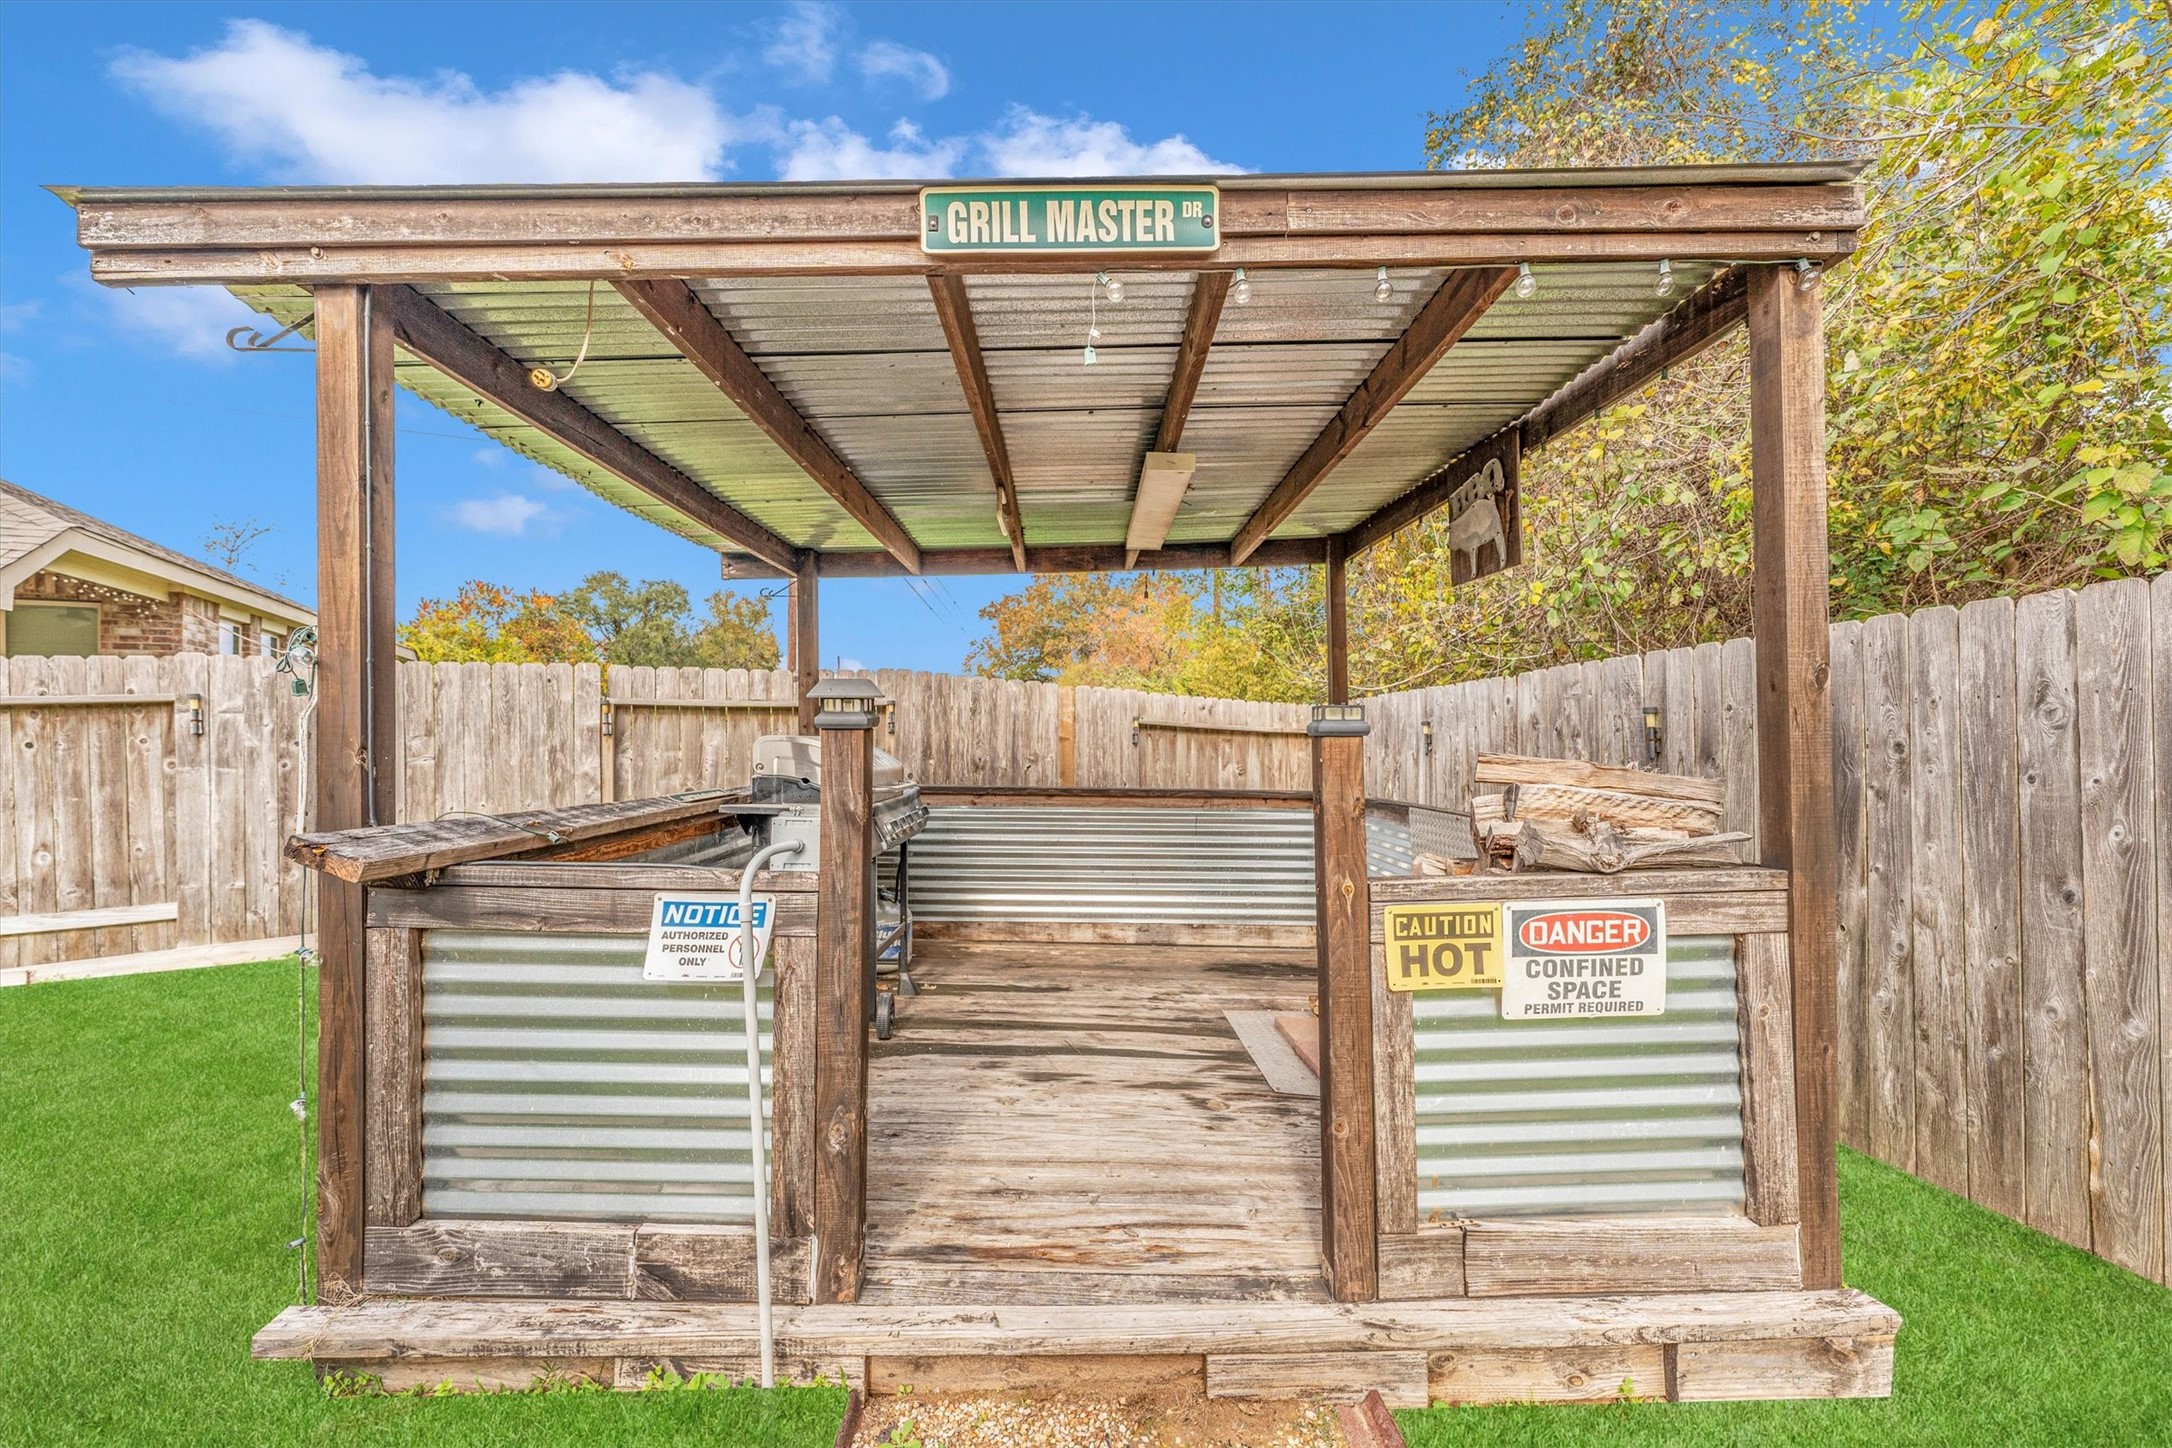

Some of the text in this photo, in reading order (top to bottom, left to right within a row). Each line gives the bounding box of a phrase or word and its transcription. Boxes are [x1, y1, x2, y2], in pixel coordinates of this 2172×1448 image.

[947, 199, 1203, 244] GRILL MASTER DR
[1449, 458, 1505, 522] BBQ
[663, 904, 764, 925] NOTICE
[661, 931, 729, 940] AUTHORIZED
[1395, 914, 1492, 938] CAUTION
[1528, 919, 1641, 946] DANGER
[662, 944, 725, 954] PERSONNEL
[678, 957, 707, 966] ONLY
[1399, 942, 1492, 978] HOT
[1525, 957, 1644, 979] CONFINED
[1547, 980, 1622, 1000] SPACE
[1524, 1000, 1644, 1015] PERMIT REQUIRED
